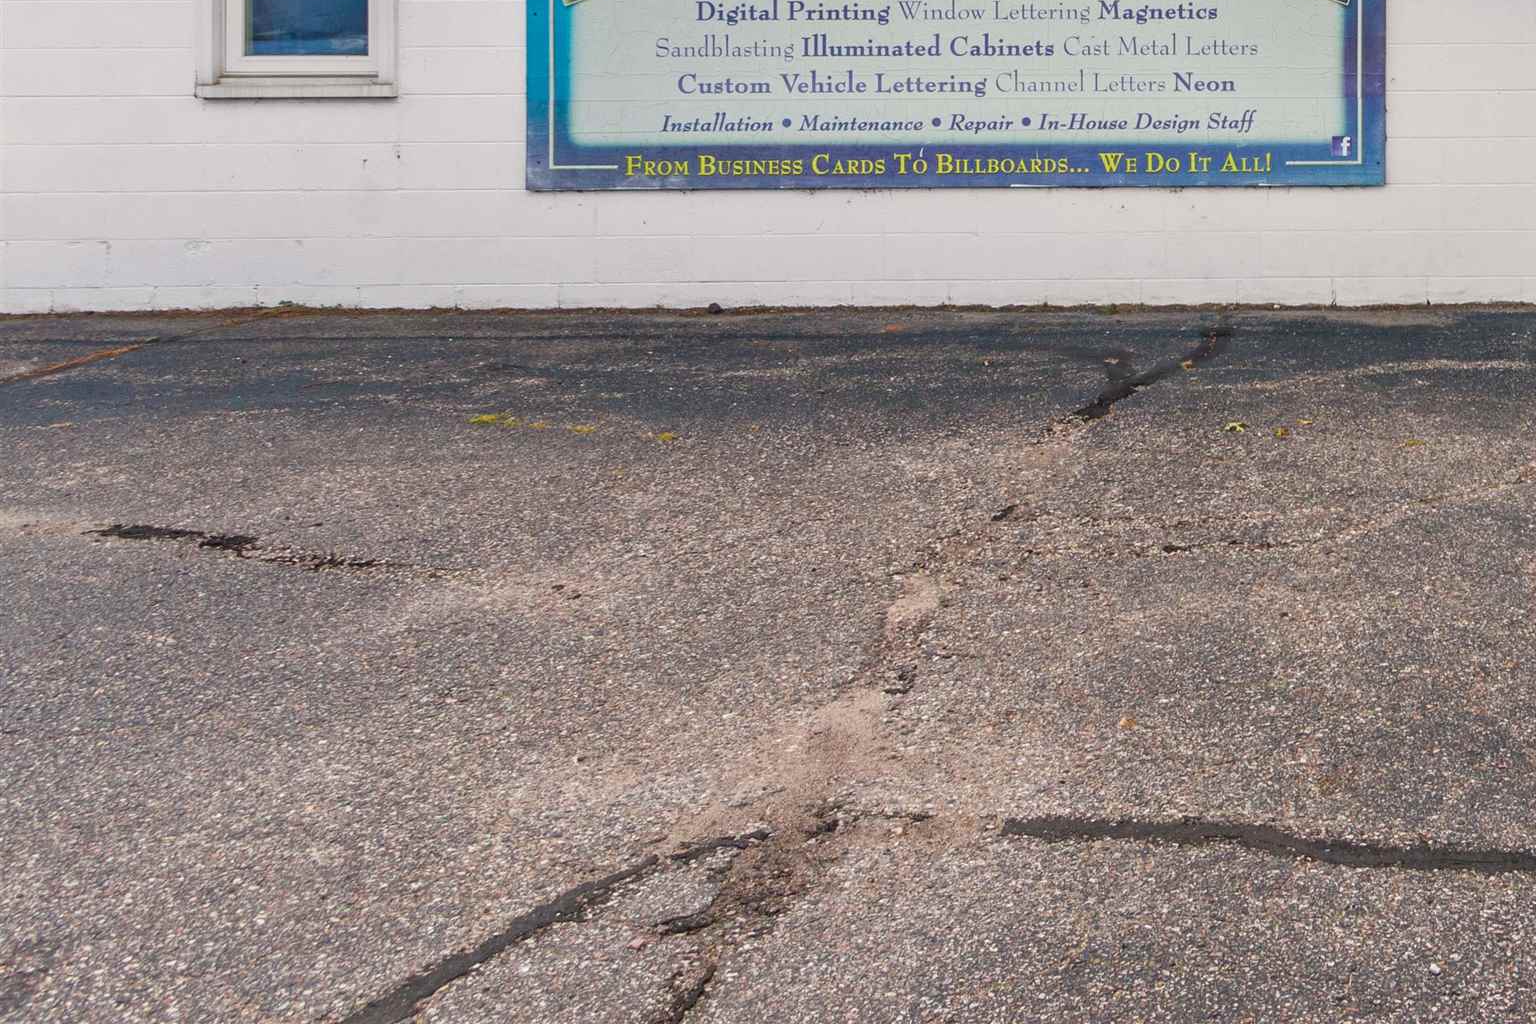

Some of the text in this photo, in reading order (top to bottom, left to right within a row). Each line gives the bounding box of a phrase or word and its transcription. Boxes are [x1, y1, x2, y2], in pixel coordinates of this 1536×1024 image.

[786, 0, 892, 26] Printing
[1097, 0, 1218, 25] Magnetics
[655, 32, 1259, 63] Sandblasting Illuminated Cabinets Cast Metal Letters
[677, 68, 1237, 98] Custom Vehicle Lettering Channel Letters Neon
[659, 108, 1258, 134] Installation Maintenance Repair In-House Design Staff
[625, 154, 690, 177] FROM
[698, 153, 803, 177] BUSINESS
[811, 153, 886, 176] CARDS
[893, 152, 929, 176] TO
[1099, 152, 1137, 174] WE
[1145, 151, 1180, 174] DO
[1188, 151, 1212, 174] IT
[1221, 151, 1273, 174] ALL!
